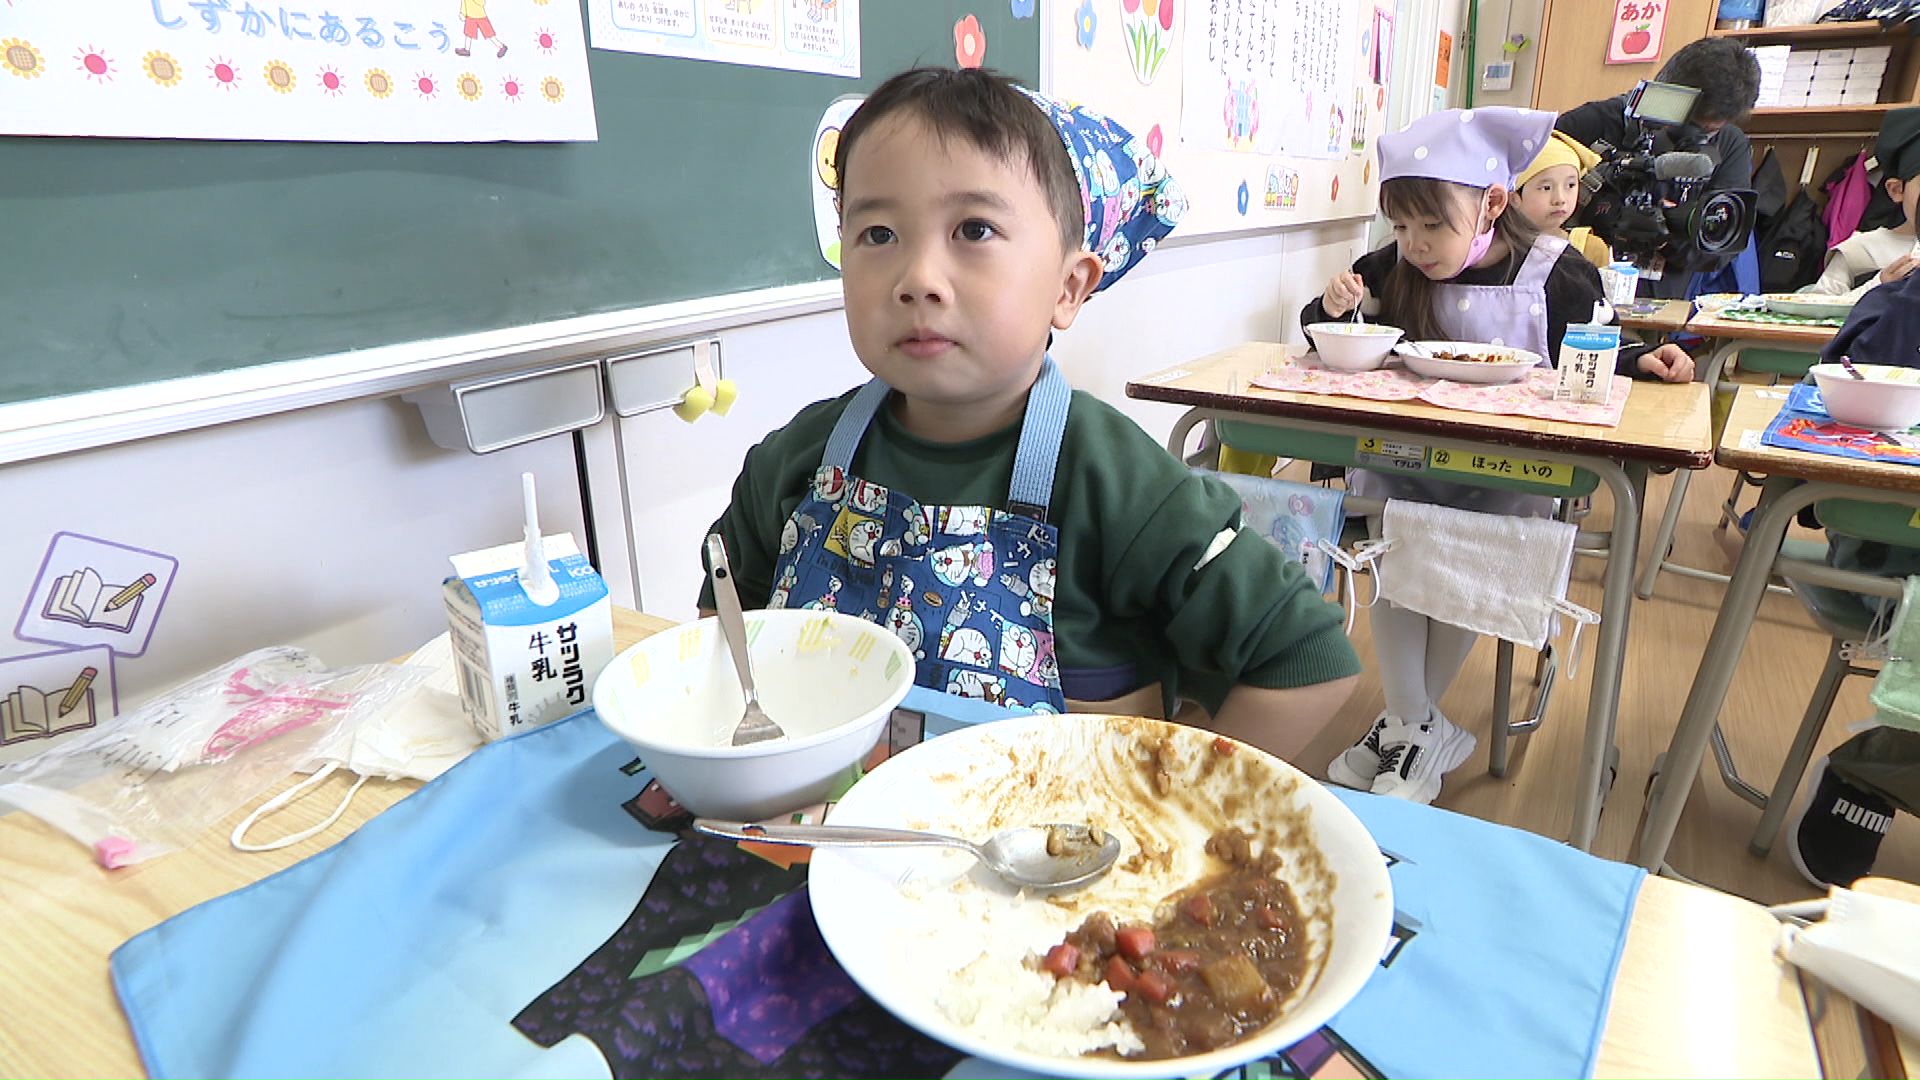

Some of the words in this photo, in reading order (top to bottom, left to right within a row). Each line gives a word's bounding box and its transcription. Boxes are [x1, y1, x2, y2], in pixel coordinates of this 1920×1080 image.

[1620, 2, 1661, 22] あか
[1472, 456, 1512, 473] ほった
[1523, 464, 1553, 478] いの
[528, 631, 558, 682] 牛乳
[556, 621, 585, 705] サツラク
